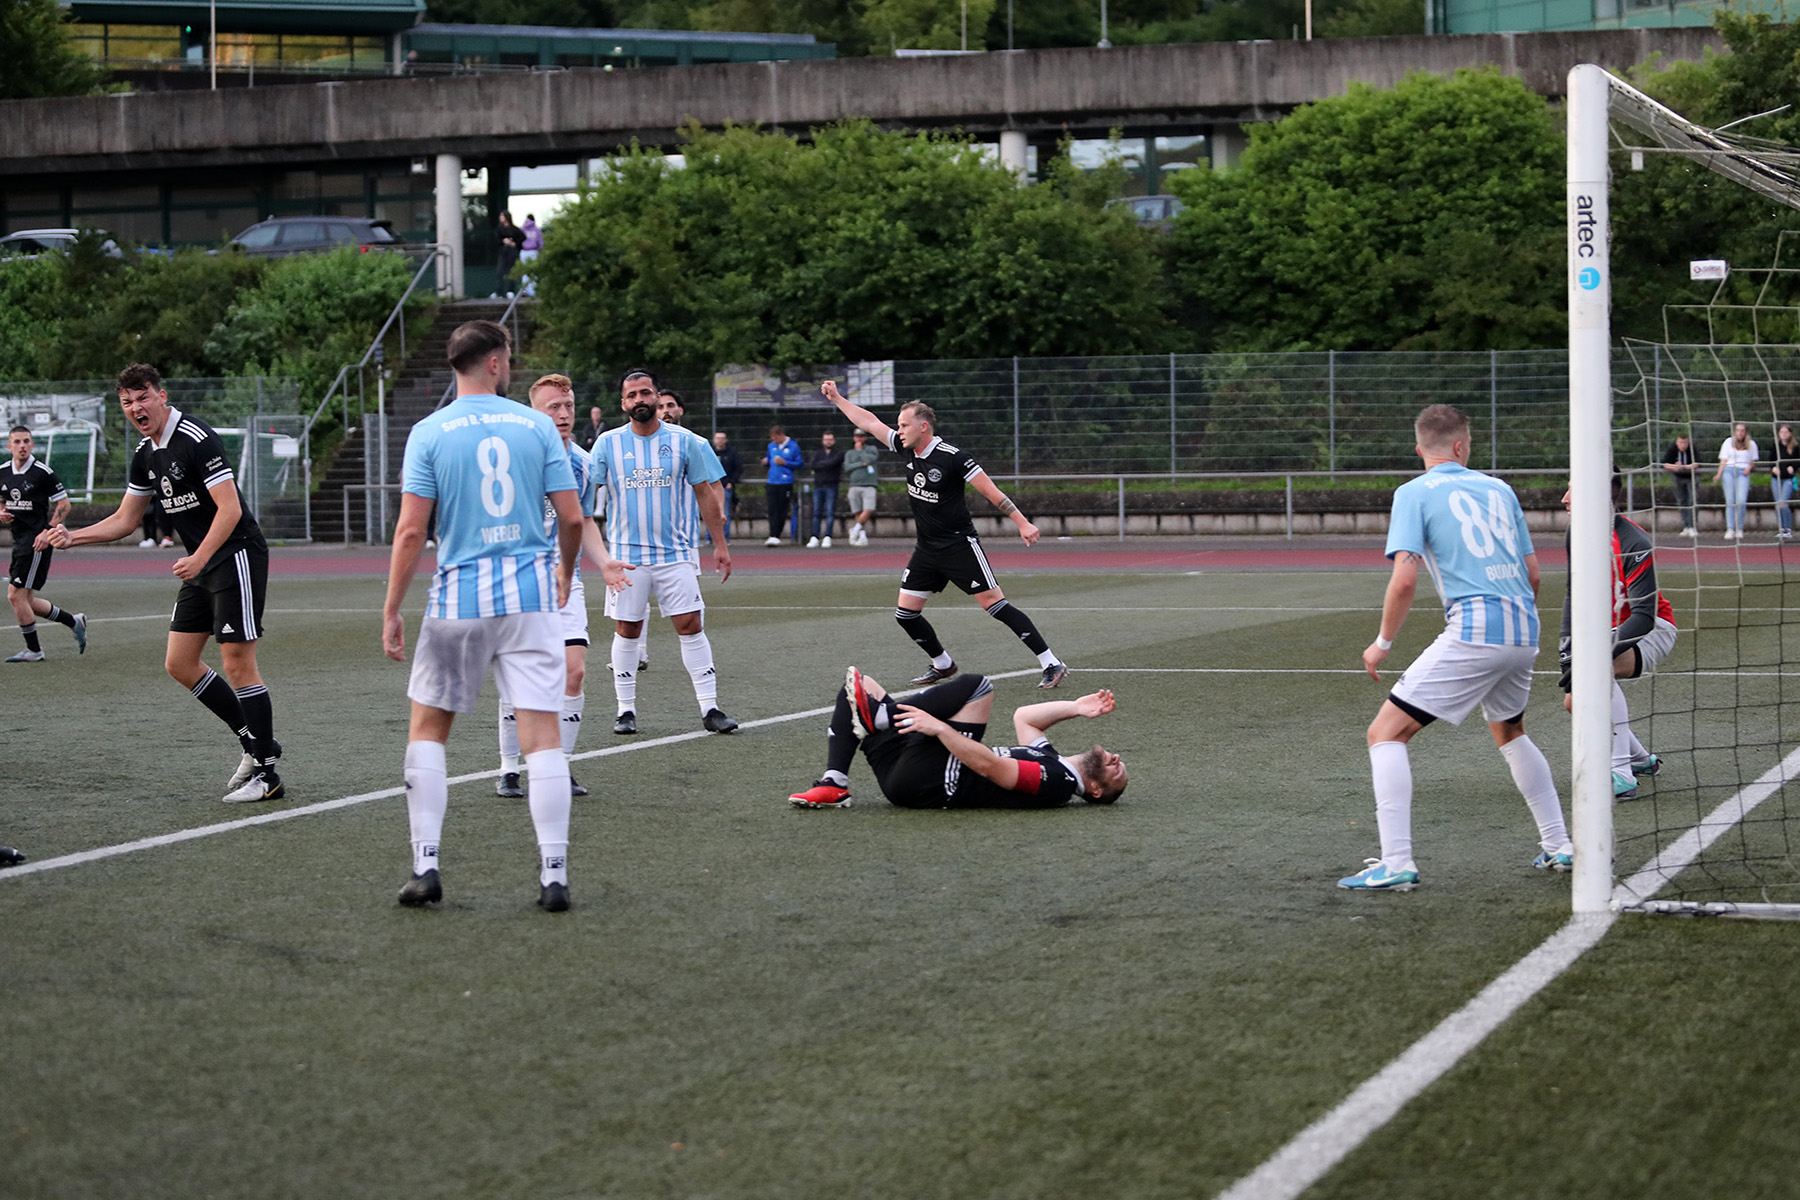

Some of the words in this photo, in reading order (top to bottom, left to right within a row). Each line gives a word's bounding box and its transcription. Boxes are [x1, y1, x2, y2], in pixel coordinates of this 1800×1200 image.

[1577, 195, 1597, 258] artec
[477, 436, 515, 518] 8
[632, 468, 665, 479] SPORT
[172, 491, 198, 507] KOCH
[481, 524, 521, 545] WEBER
[1448, 490, 1518, 559] 84
